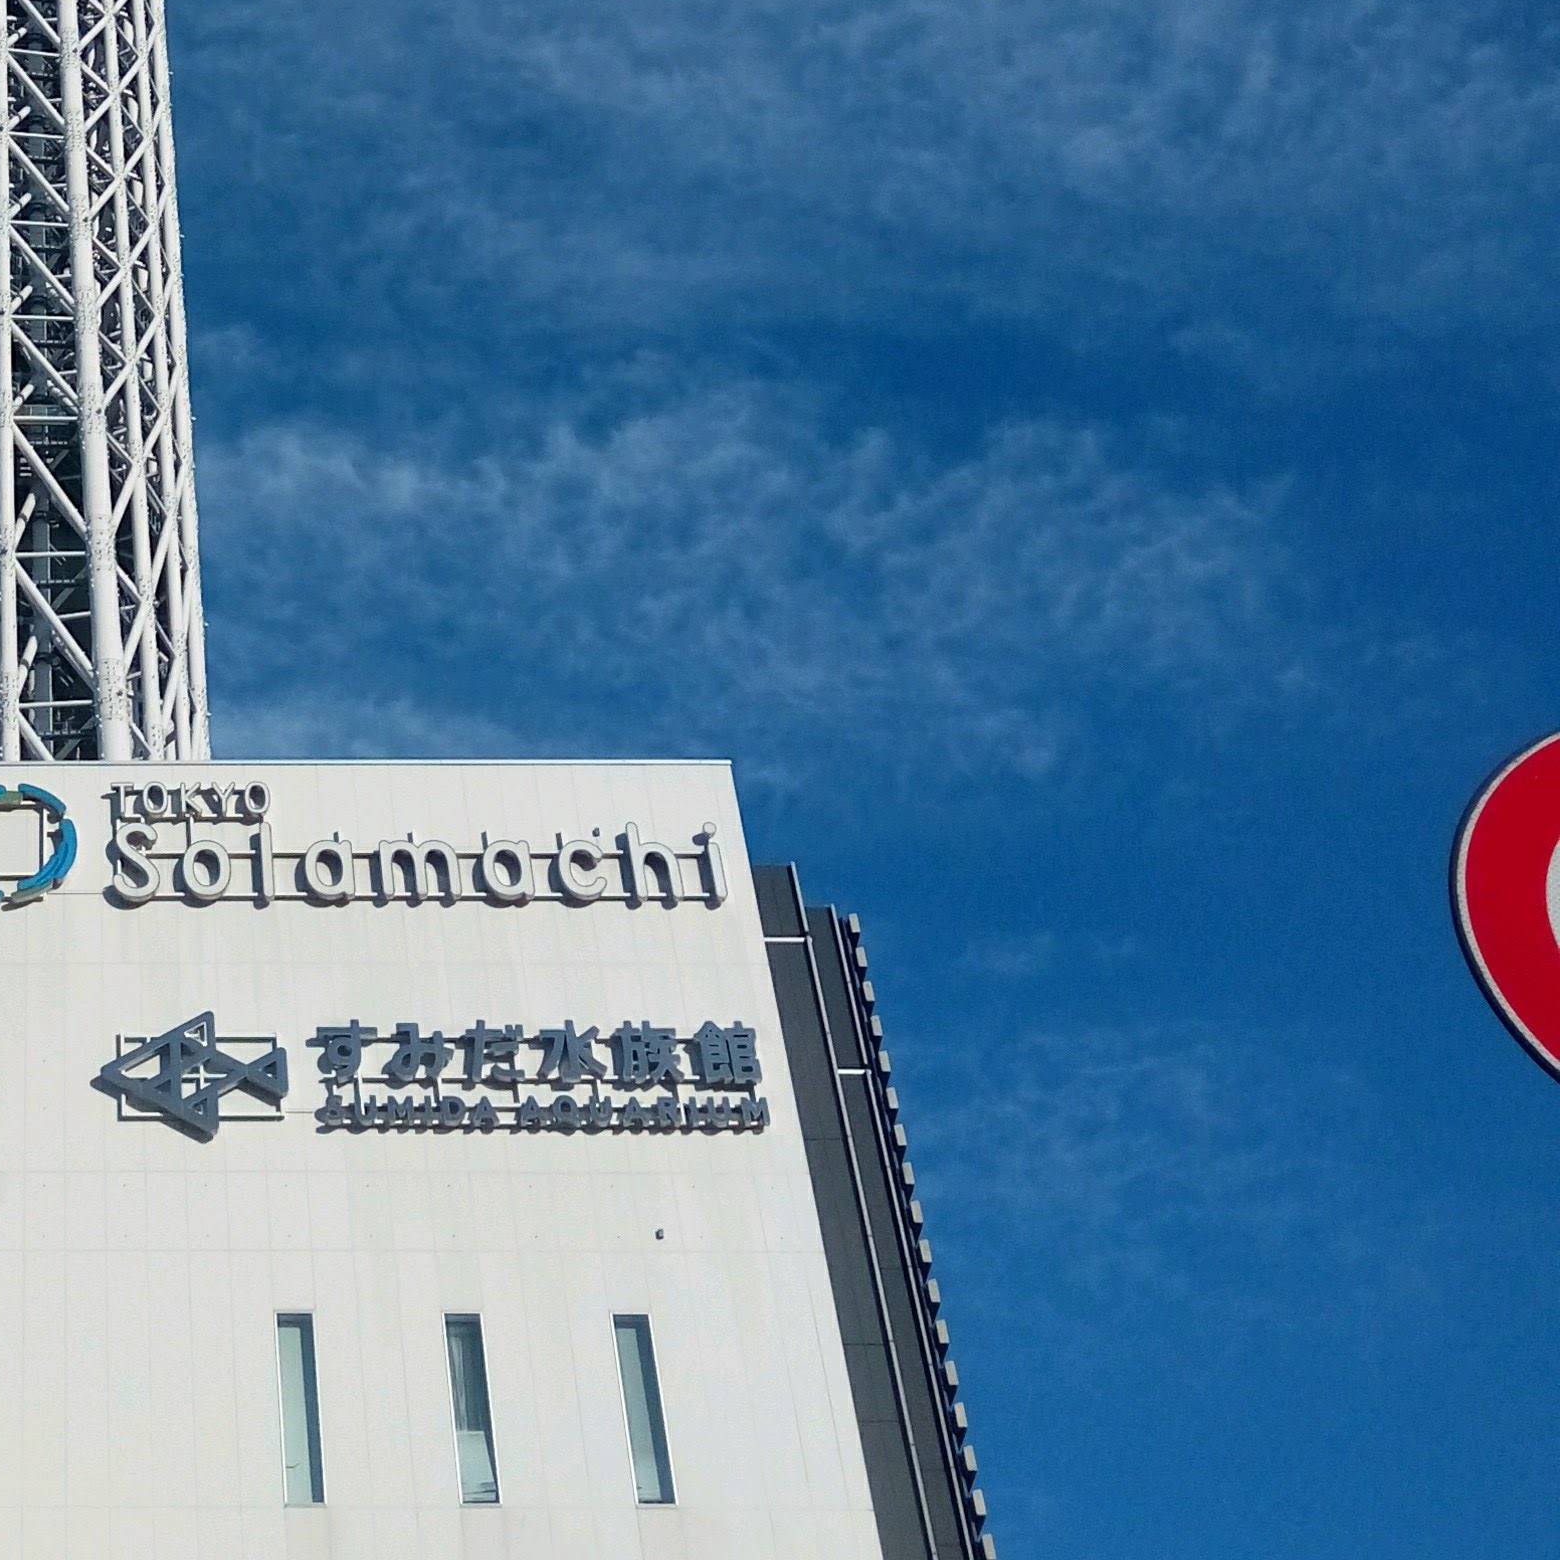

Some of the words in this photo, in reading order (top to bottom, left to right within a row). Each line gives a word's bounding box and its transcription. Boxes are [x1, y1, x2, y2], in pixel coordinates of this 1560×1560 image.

[111, 781, 271, 816] TOKYO
[112, 820, 728, 903] Solamachi
[316, 1019, 762, 1084] すみだ水族館
[325, 1095, 499, 1127] SUMIDA
[520, 1095, 771, 1128] AQUARIUM
